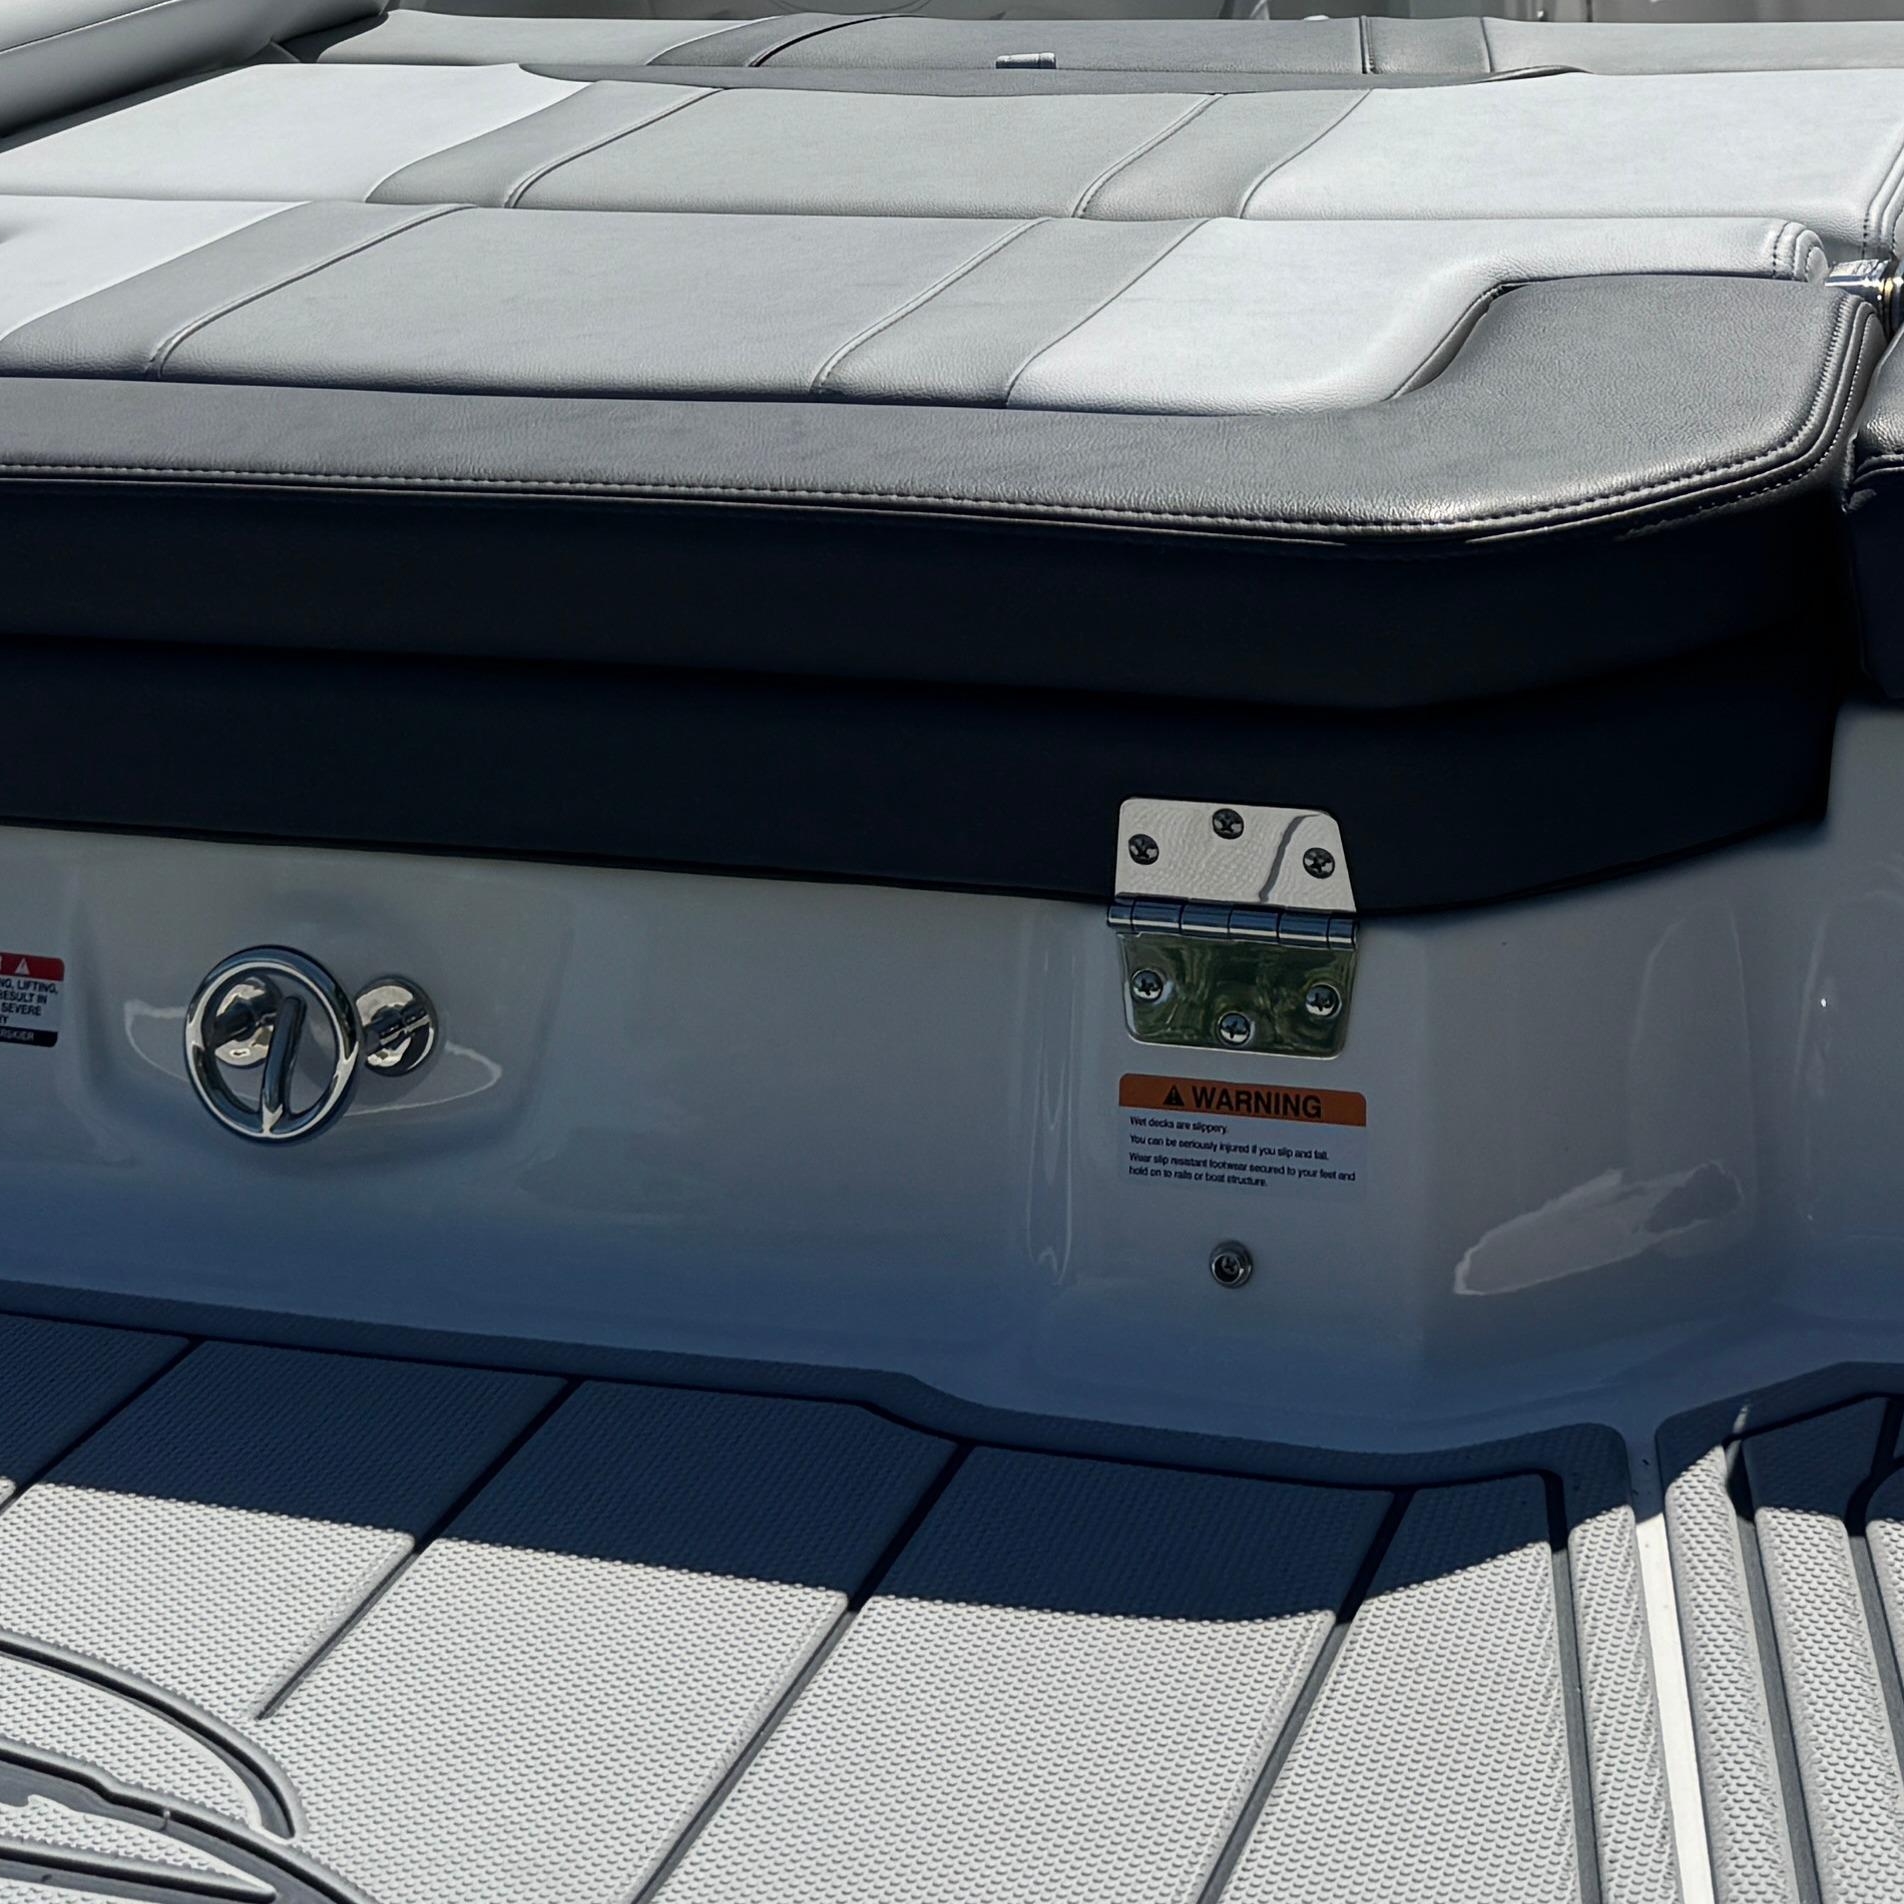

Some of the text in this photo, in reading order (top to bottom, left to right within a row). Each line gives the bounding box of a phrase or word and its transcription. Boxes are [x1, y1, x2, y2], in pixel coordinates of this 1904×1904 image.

[17, 979, 58, 994] LIFTING,
[37, 993, 47, 1004] IN
[1, 1002, 41, 1016] SEVERE
[1191, 1084, 1322, 1119] WARNING
